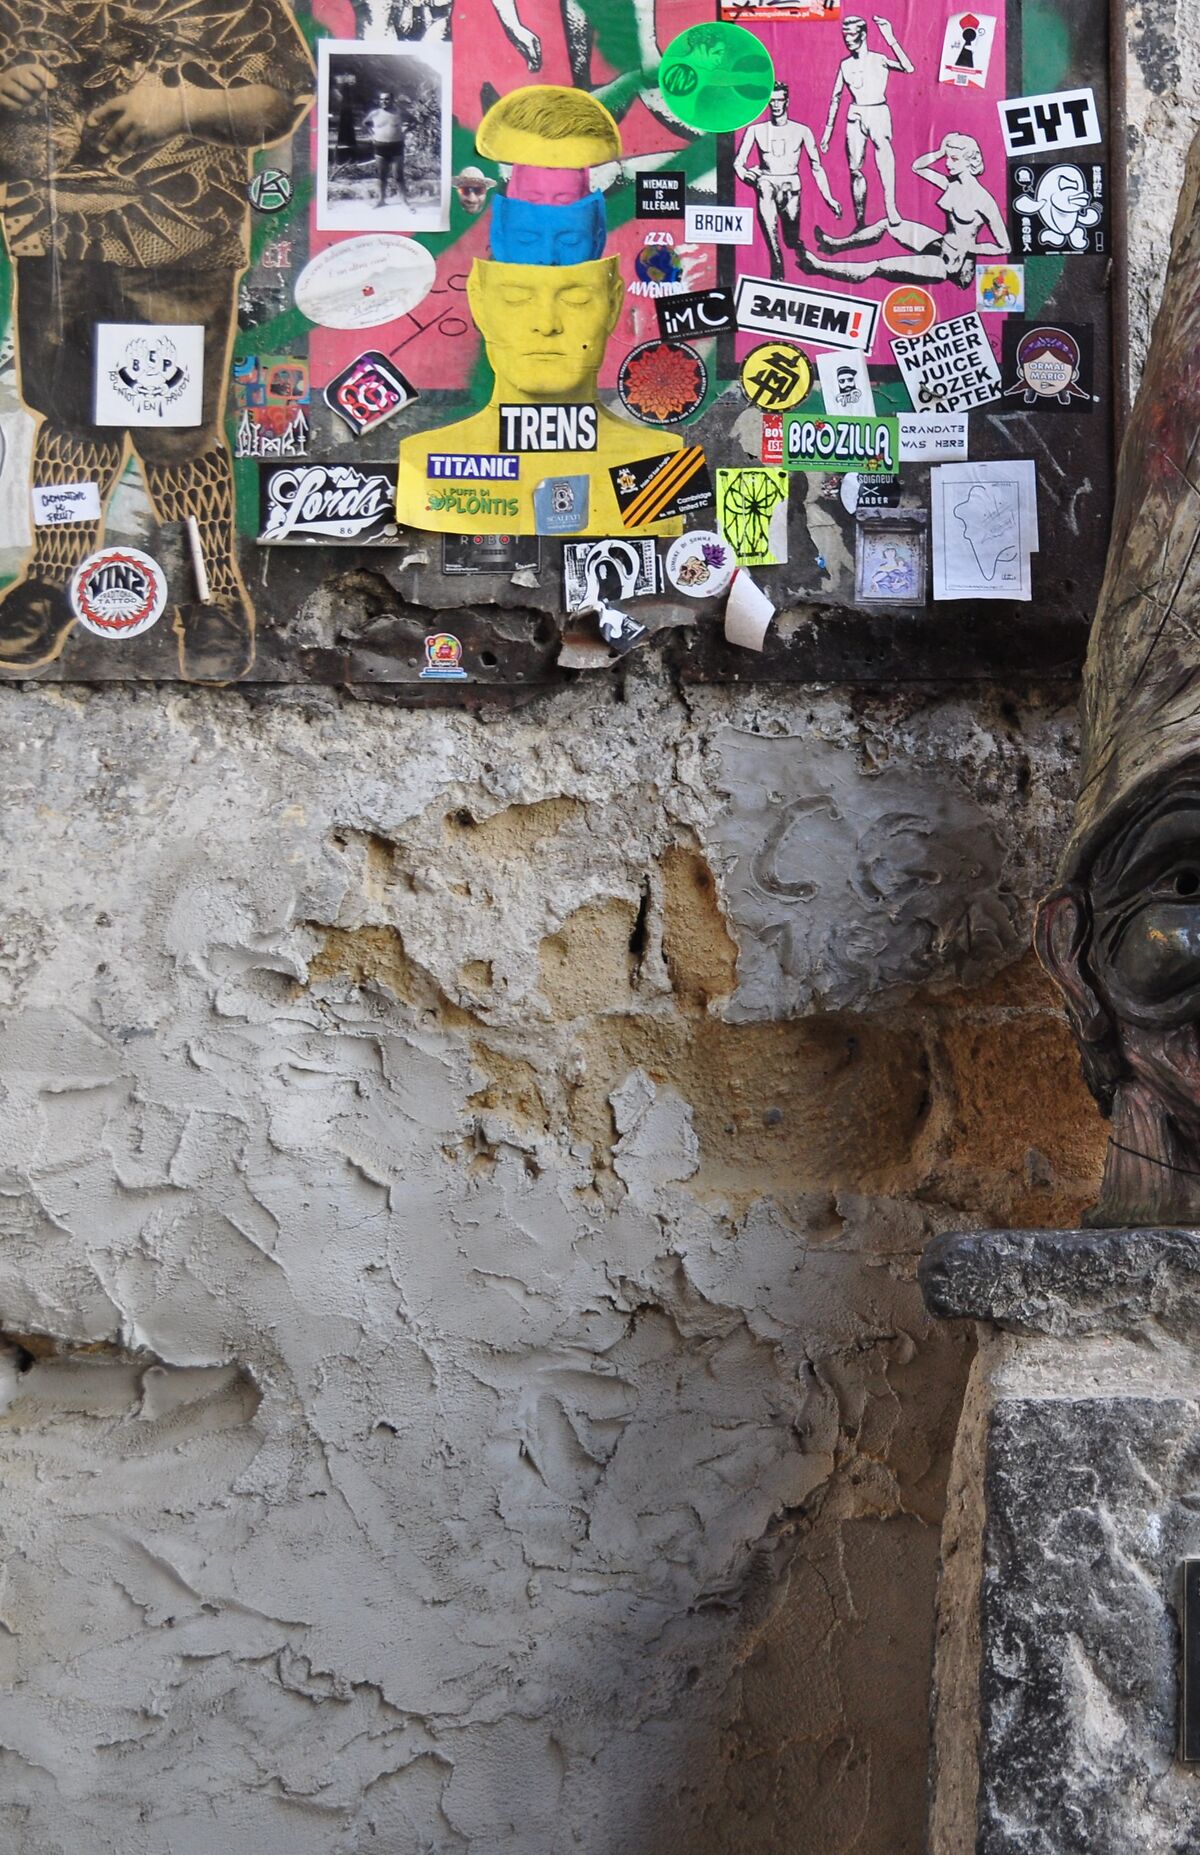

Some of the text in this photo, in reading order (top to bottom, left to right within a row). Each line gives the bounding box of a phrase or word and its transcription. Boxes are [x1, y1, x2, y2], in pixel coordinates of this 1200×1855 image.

[1005, 99, 1089, 148] SYT
[643, 180, 678, 190] NIEMAND
[655, 191, 663, 199] IS
[642, 201, 680, 210] ILLEGAAL
[695, 214, 743, 232] BRONX
[750, 295, 862, 338] ЗАЧЕМ!
[895, 316, 979, 356] SPACER
[904, 333, 982, 371] NAMER
[919, 352, 982, 385] JUICE
[1029, 362, 1065, 371] ORMAI
[1030, 372, 1067, 381] MARIO
[144, 400, 156, 410] EN
[501, 406, 597, 450] TRENS
[901, 425, 965, 434] GRANDATE
[787, 420, 893, 468] BROZILLA
[902, 440, 965, 449] WAS HERE
[430, 456, 517, 478] TITANIC
[450, 488, 477, 496] PUFFI
[677, 492, 712, 504] Cambridge
[261, 466, 392, 539] Lords
[679, 500, 708, 512] United FC
